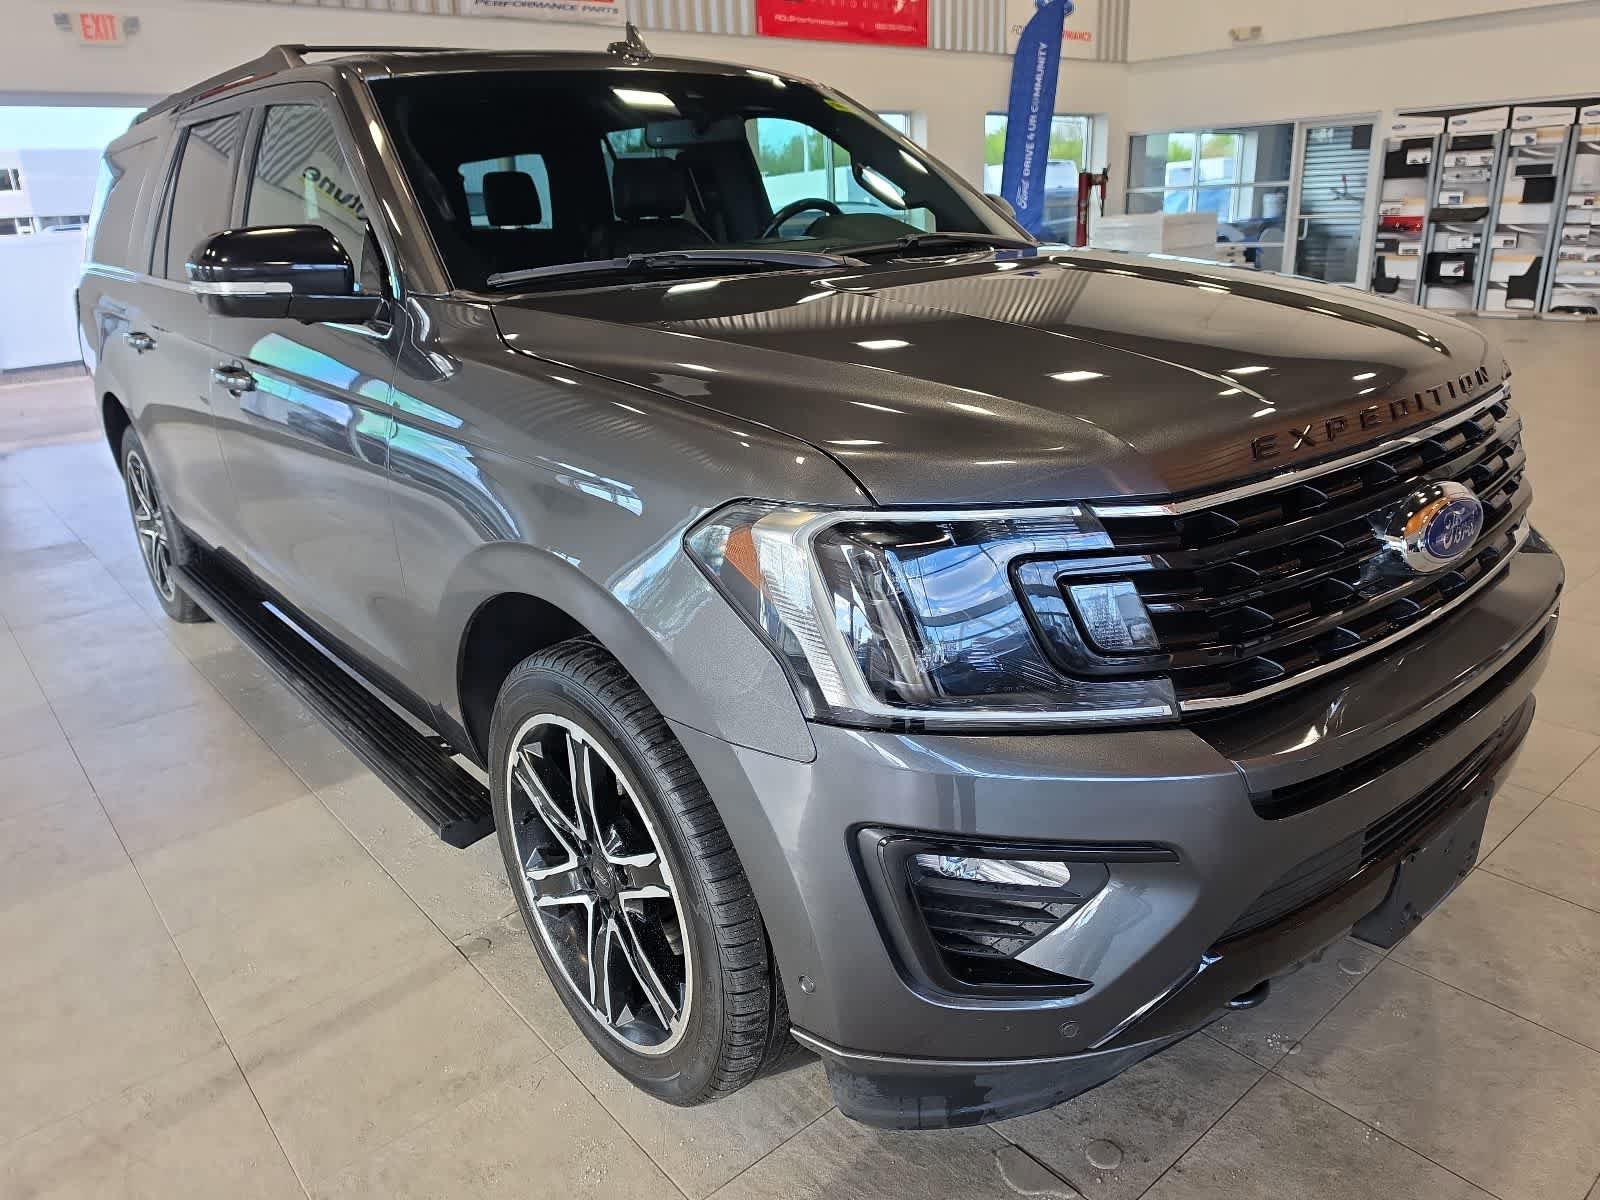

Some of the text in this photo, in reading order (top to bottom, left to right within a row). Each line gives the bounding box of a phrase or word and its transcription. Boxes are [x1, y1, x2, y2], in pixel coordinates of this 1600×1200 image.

[80, 13, 117, 41] EXIT
[1031, 42, 1048, 113] COMMUNITY
[1028, 114, 1038, 132] UR
[1023, 142, 1035, 176] DRIVE
[1249, 366, 1489, 461] EXPEDITION
[1438, 505, 1475, 549] Ford
